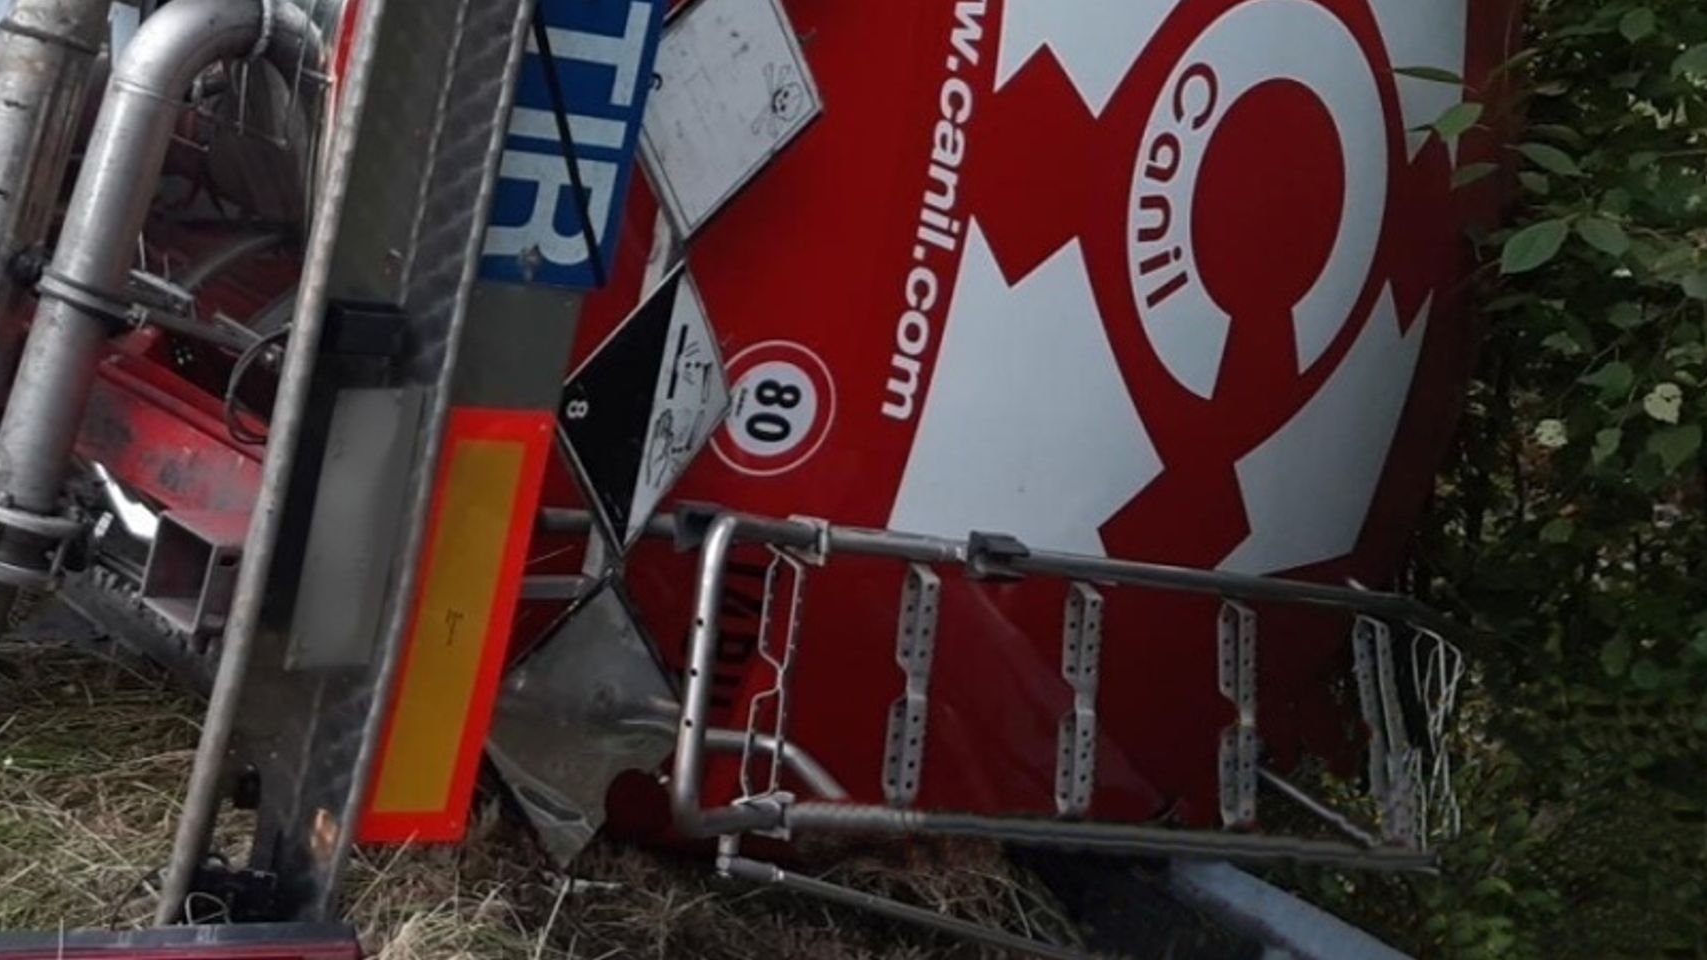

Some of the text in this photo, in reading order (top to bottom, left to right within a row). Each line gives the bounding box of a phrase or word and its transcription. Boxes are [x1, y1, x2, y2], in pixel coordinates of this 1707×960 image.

[482, 1, 652, 266] TIR
[1137, 62, 1218, 308] Canil
[566, 398, 588, 419] 8
[745, 379, 801, 443] 80
